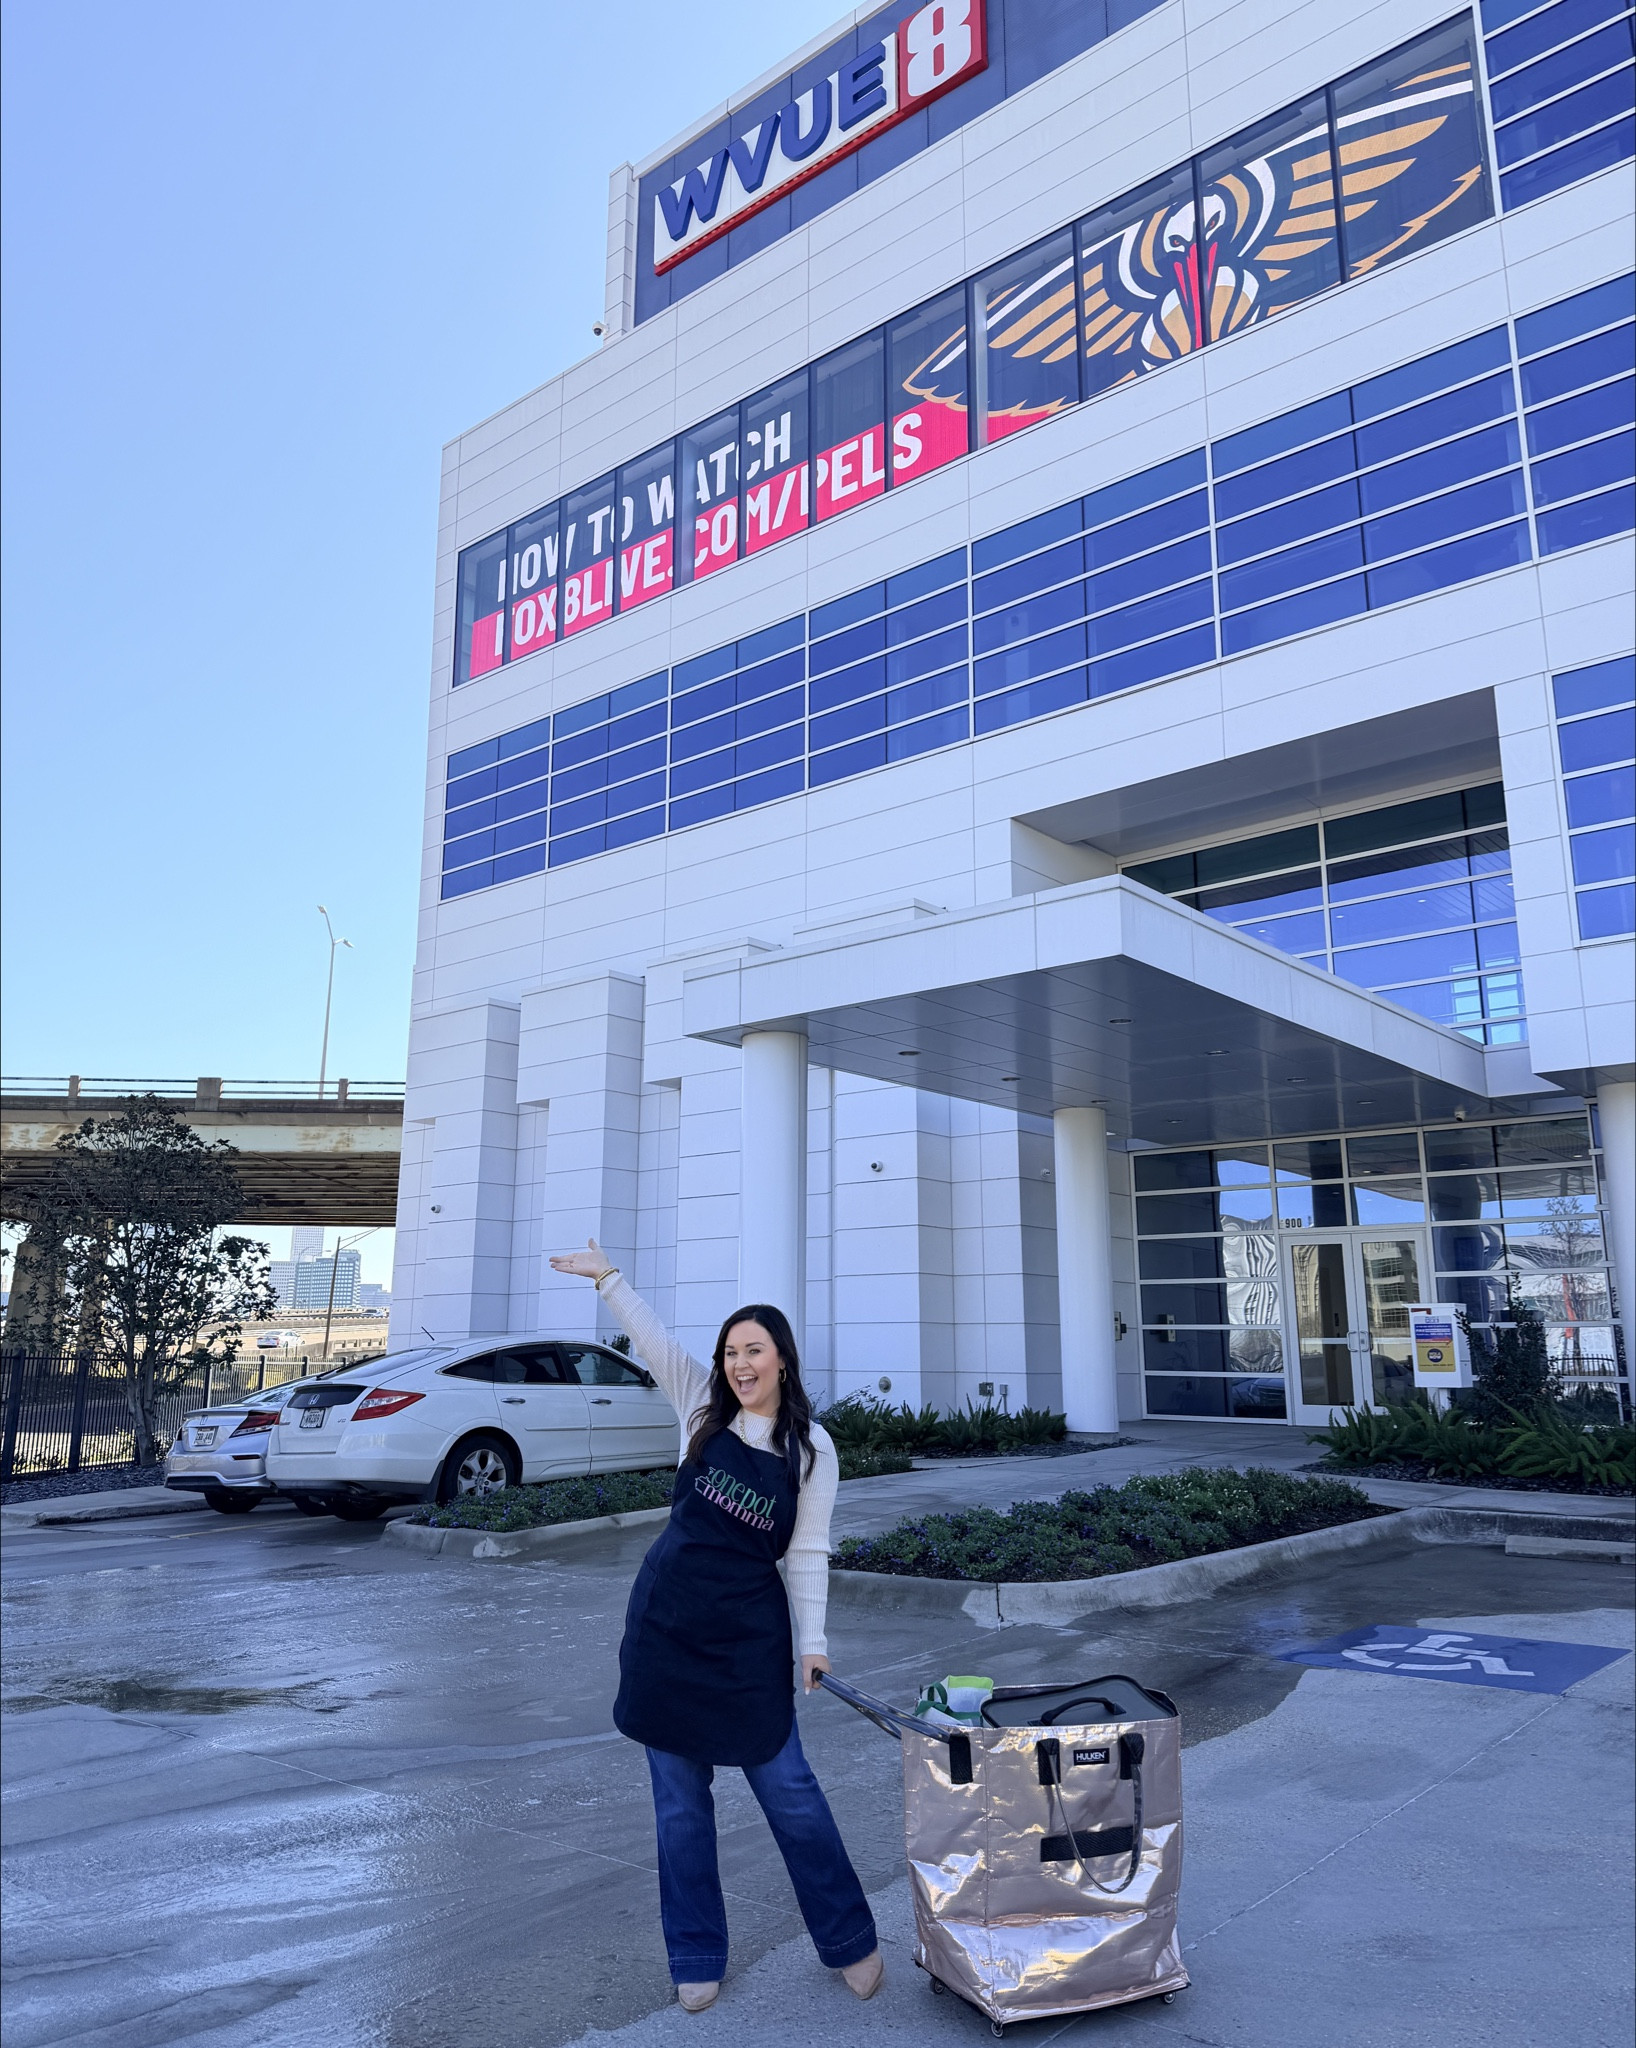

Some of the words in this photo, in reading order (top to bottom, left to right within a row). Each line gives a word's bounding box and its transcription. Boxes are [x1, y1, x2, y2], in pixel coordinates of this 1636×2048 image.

[657, 41, 886, 242] WVUE
[907, 0, 971, 96] 8
[587, 497, 634, 556] TO
[1285, 1218, 1302, 1228] 900
[702, 1484, 774, 1531] momma
[711, 1469, 777, 1518] onepot
[1076, 1751, 1105, 1760] HULKEN
